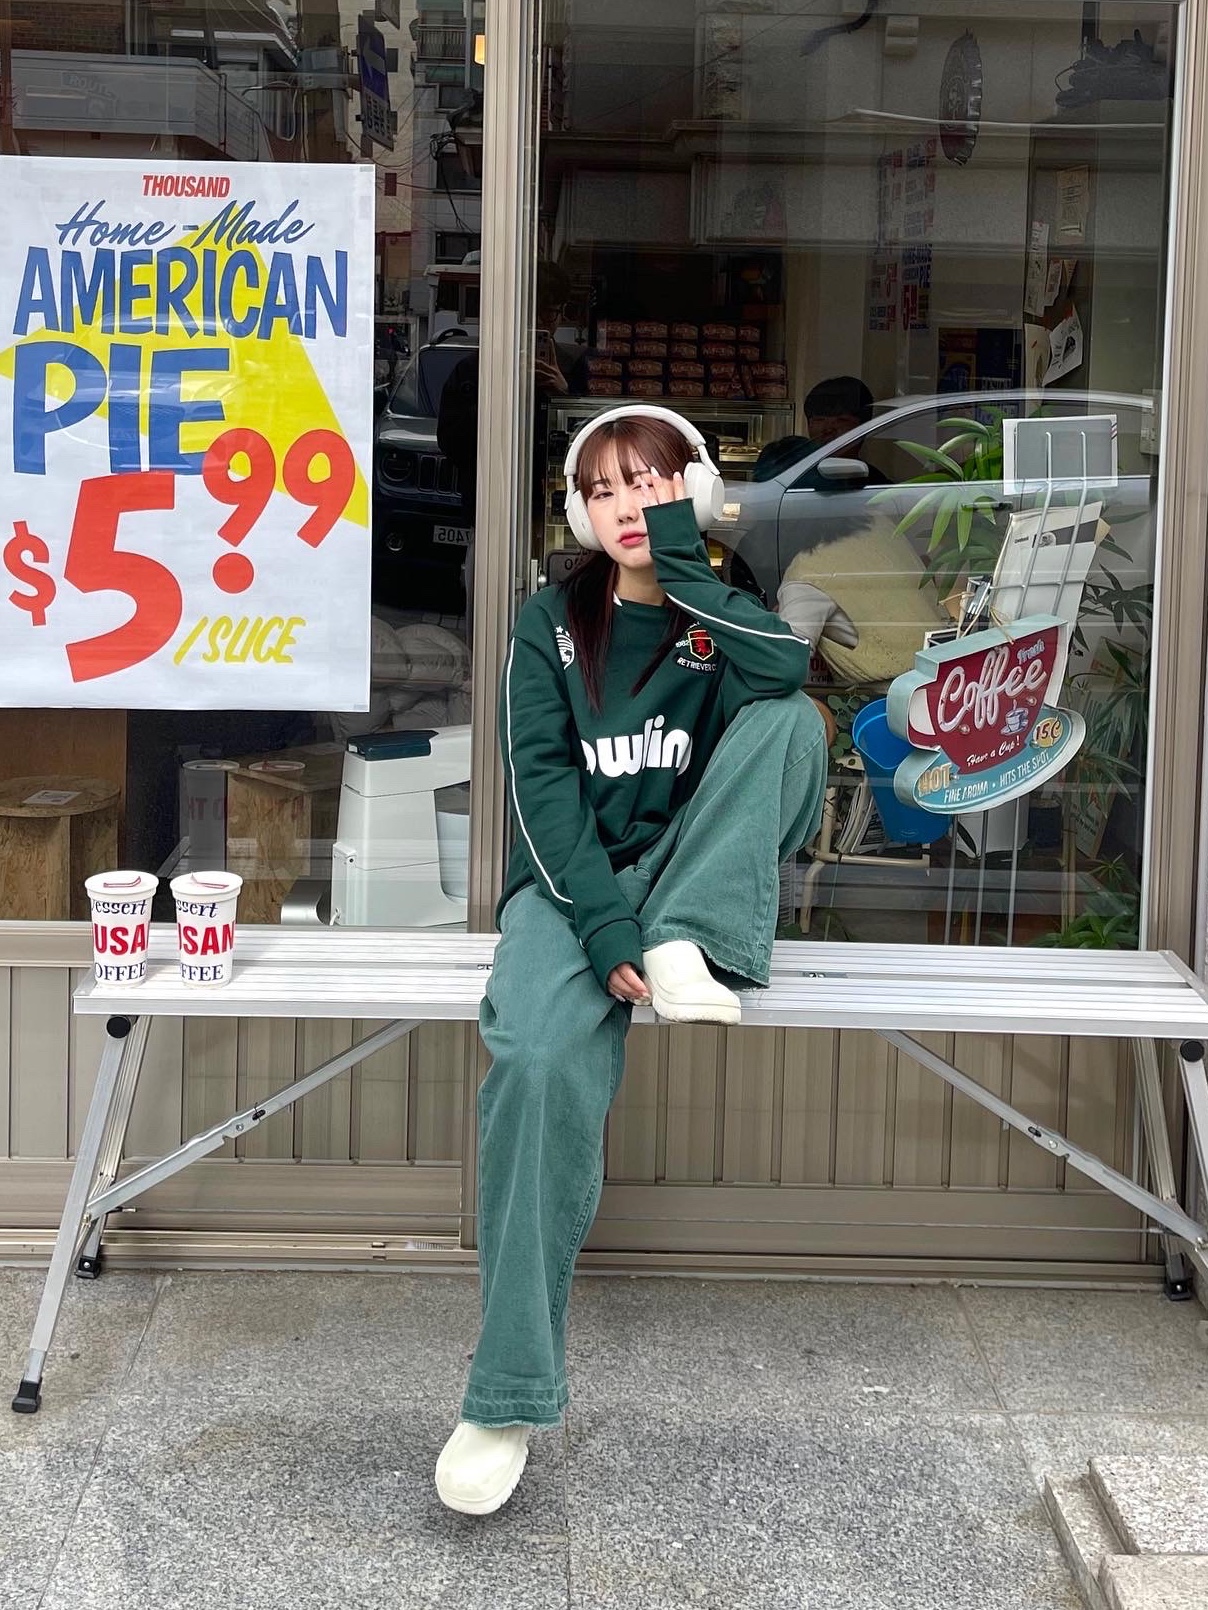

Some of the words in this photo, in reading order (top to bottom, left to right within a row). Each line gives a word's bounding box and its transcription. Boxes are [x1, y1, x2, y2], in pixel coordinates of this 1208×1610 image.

[142, 174, 231, 198] THOUSAND
[12, 246, 349, 339] AMERICAN
[13, 340, 230, 475] PIE
[677, 657, 711, 672] RETRIEVER
[937, 645, 1048, 732] Coffee
[966, 753, 988, 767] Have
[990, 749, 996, 757] a
[917, 762, 952, 797] HOT
[943, 788, 962, 804] FINE
[961, 780, 989, 800] AROMA
[999, 769, 1017, 788] HITS
[1017, 760, 1032, 778] THE
[91, 898, 148, 916] essert
